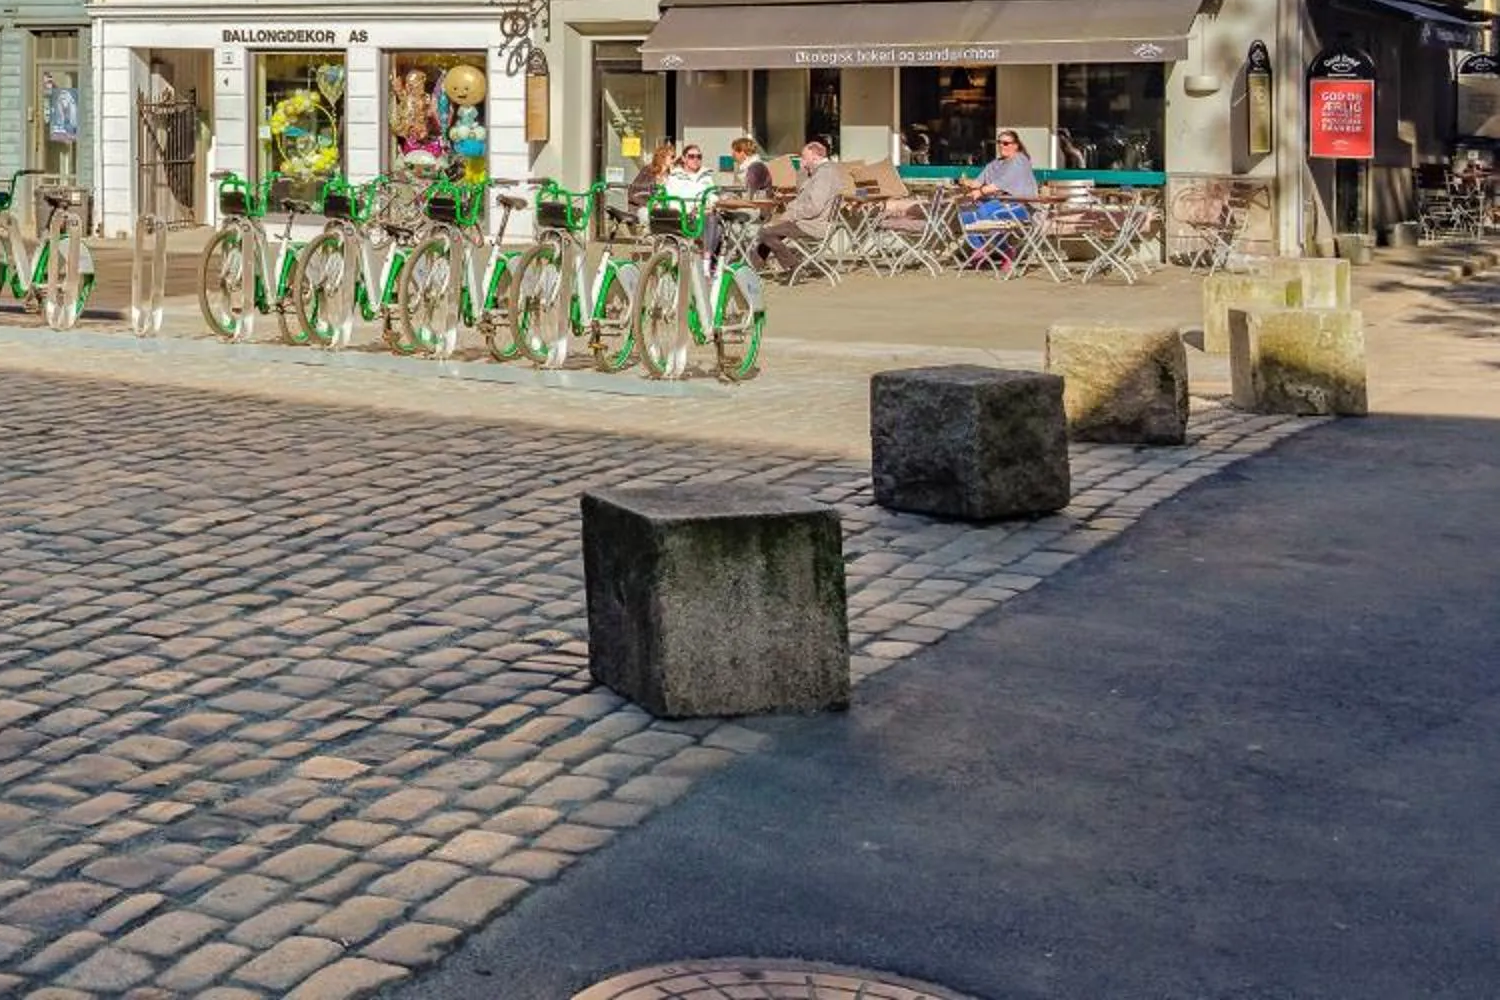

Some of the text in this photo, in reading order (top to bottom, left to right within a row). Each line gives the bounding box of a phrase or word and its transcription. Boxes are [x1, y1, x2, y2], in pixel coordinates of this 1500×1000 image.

[222, 29, 369, 44] BALLONGDEKOR AS
[795, 50, 853, 65] Økologisk
